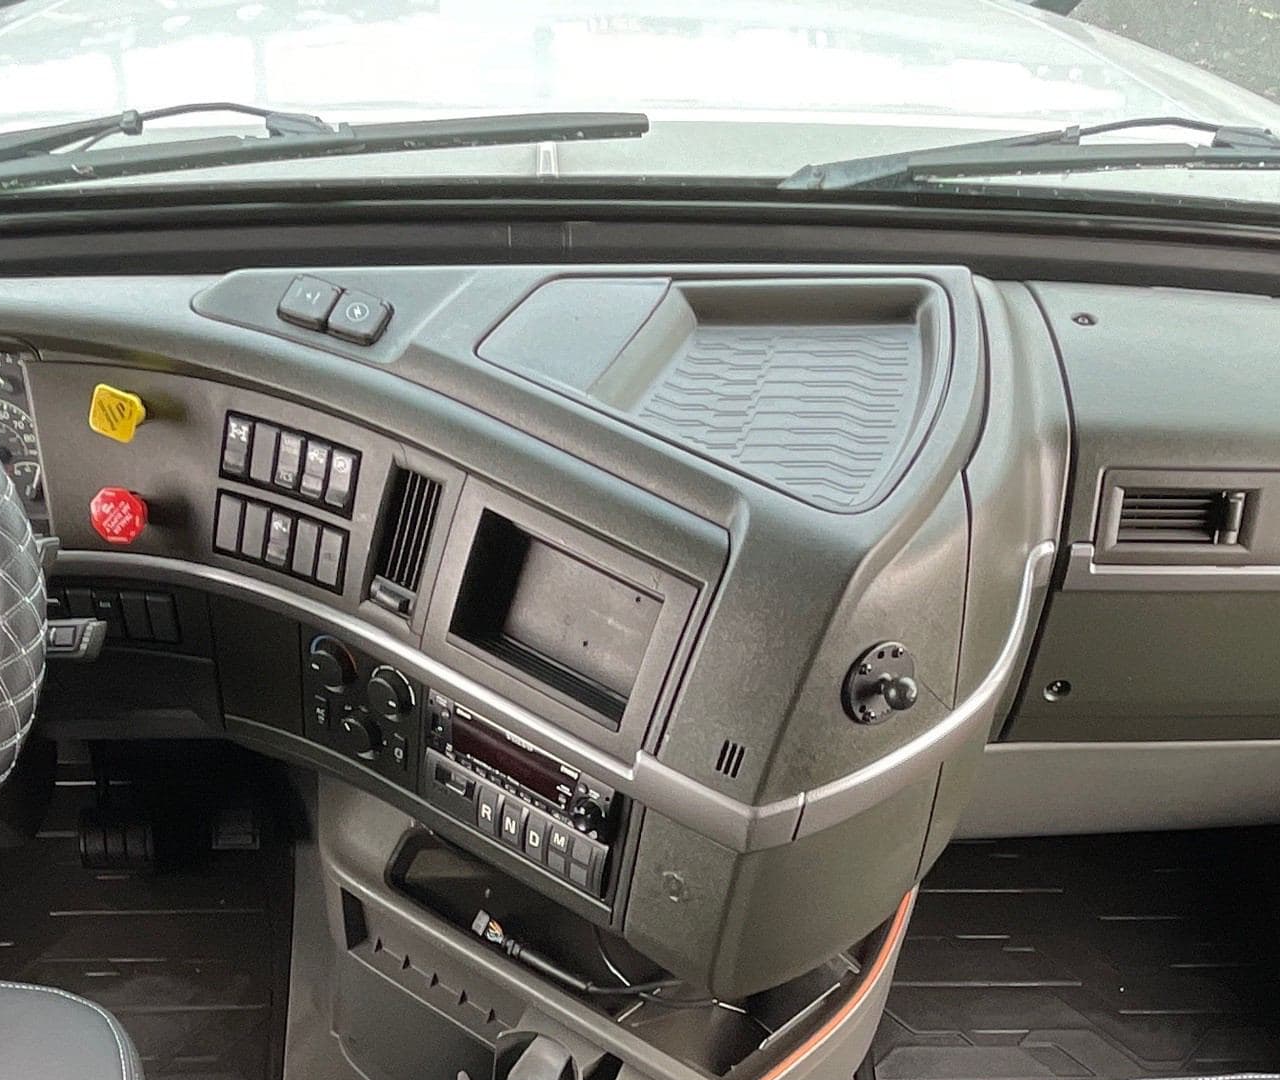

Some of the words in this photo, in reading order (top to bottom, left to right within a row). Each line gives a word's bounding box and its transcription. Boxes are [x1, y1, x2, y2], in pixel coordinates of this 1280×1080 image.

[13, 420, 25, 430] 70
[481, 803, 492, 821] R
[504, 816, 516, 834] N
[529, 830, 540, 848] D
[553, 832, 566, 848] M
